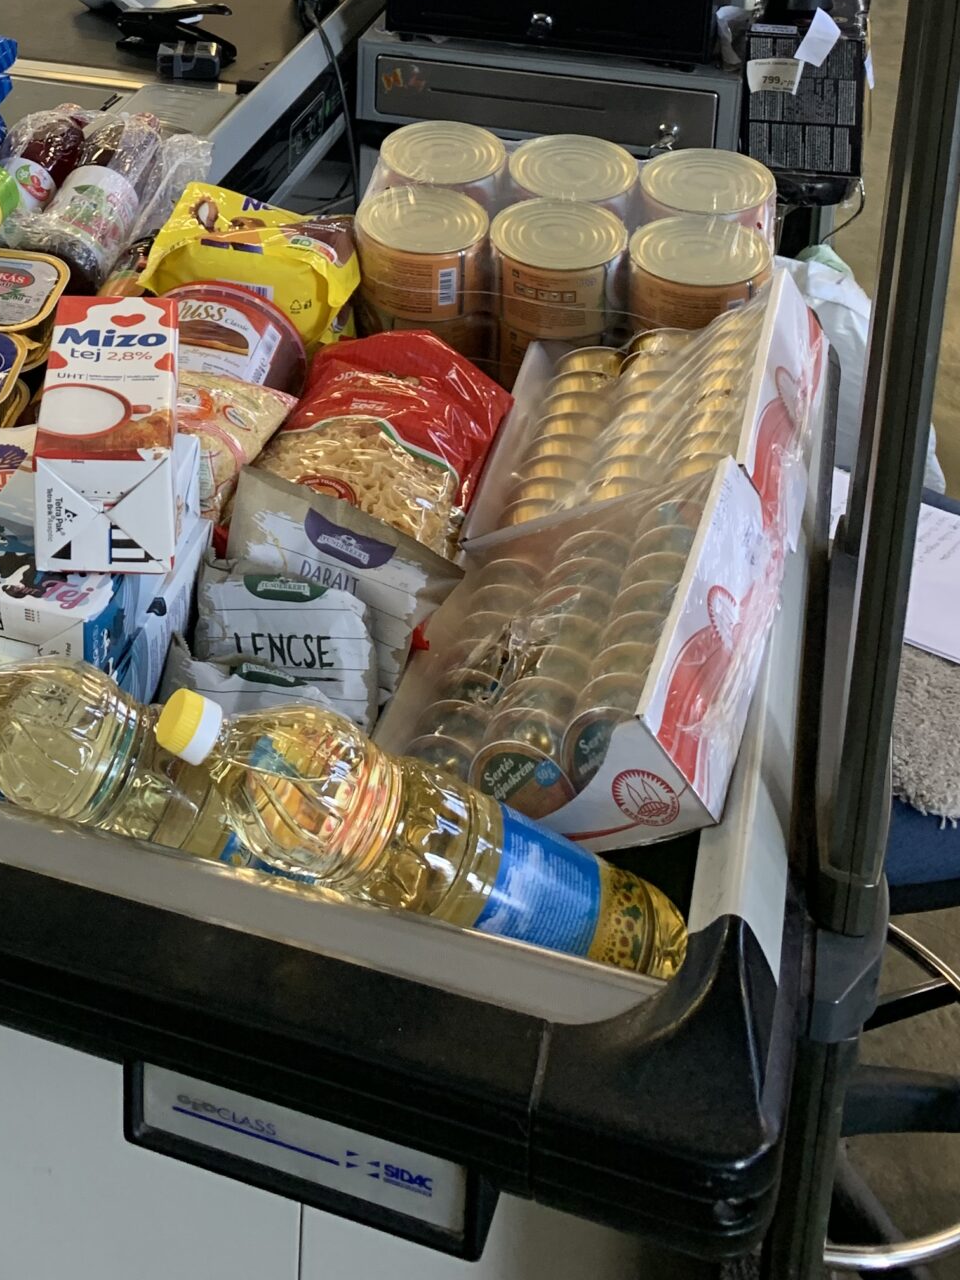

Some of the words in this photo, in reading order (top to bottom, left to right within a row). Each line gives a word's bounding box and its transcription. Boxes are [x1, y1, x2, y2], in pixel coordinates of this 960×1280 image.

[56, 327, 168, 348] Mizo
[69, 347, 101, 362] tej
[107, 351, 153, 362] 2,8%
[56, 372, 85, 380] UHT
[46, 487, 54, 502] Tetra
[55, 497, 63, 517] Tetra
[55, 517, 66, 537] Pak®
[40, 579, 94, 609] Tej
[233, 631, 335, 669] LENCSE
[483, 758, 515, 787] Sertés
[493, 761, 536, 800] ájaskrém
[382, 1163, 434, 1191] SIDAC
